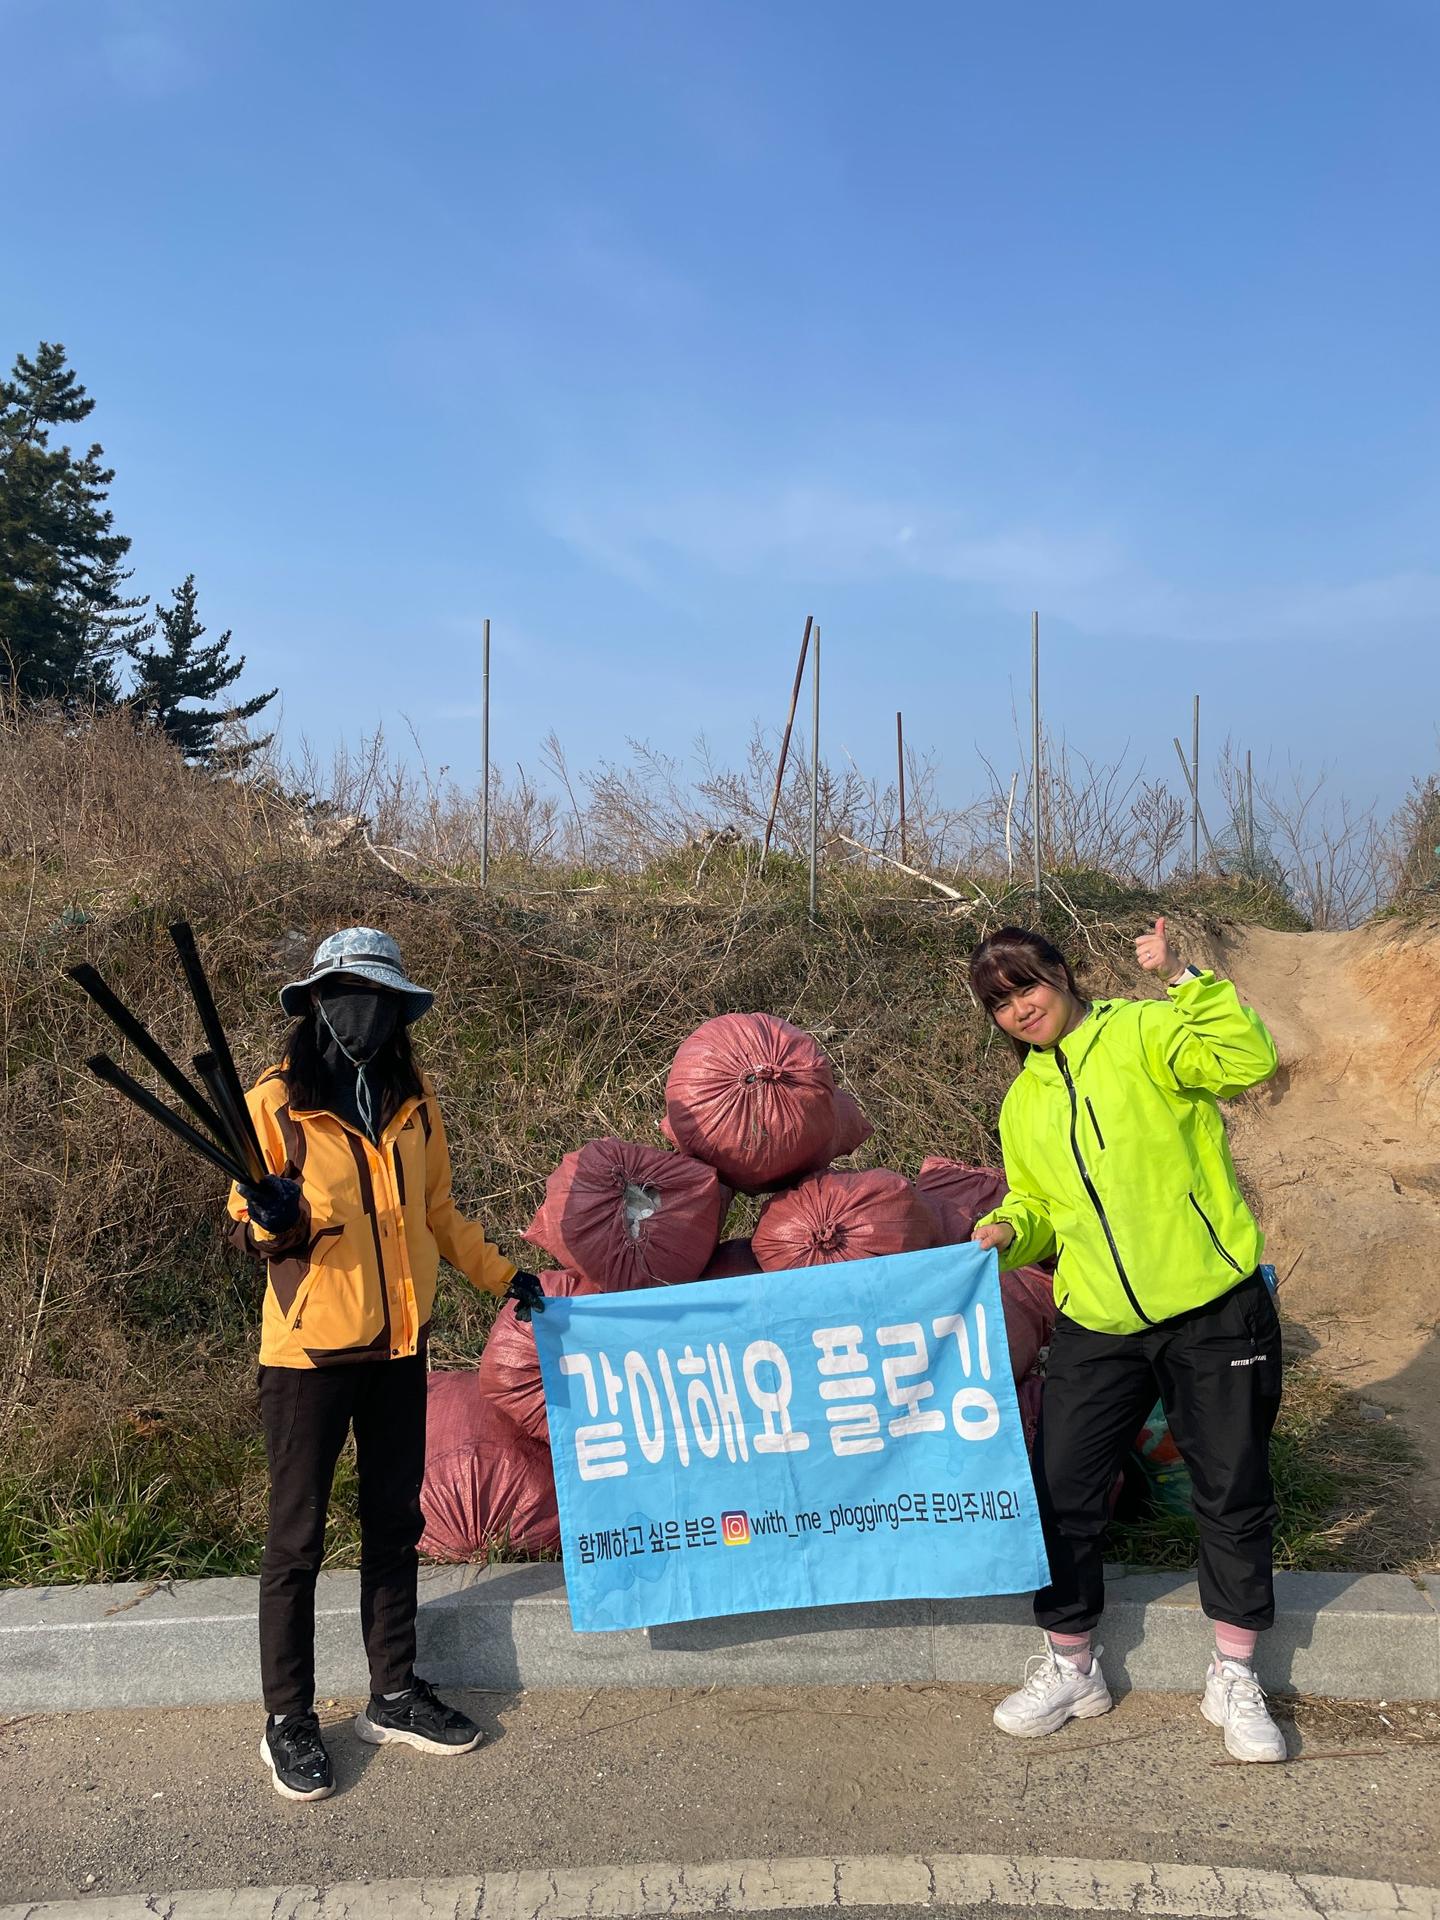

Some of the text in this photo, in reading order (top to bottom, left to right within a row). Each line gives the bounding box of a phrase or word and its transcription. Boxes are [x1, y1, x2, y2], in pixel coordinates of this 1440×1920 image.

[559, 1303, 1001, 1482] 같이해요 플로깅
[578, 1526, 645, 1565] 함께하고
[649, 1520, 681, 1554] 싶은
[685, 1516, 718, 1548] 분은
[932, 1490, 1021, 1524] 문의주세요!
